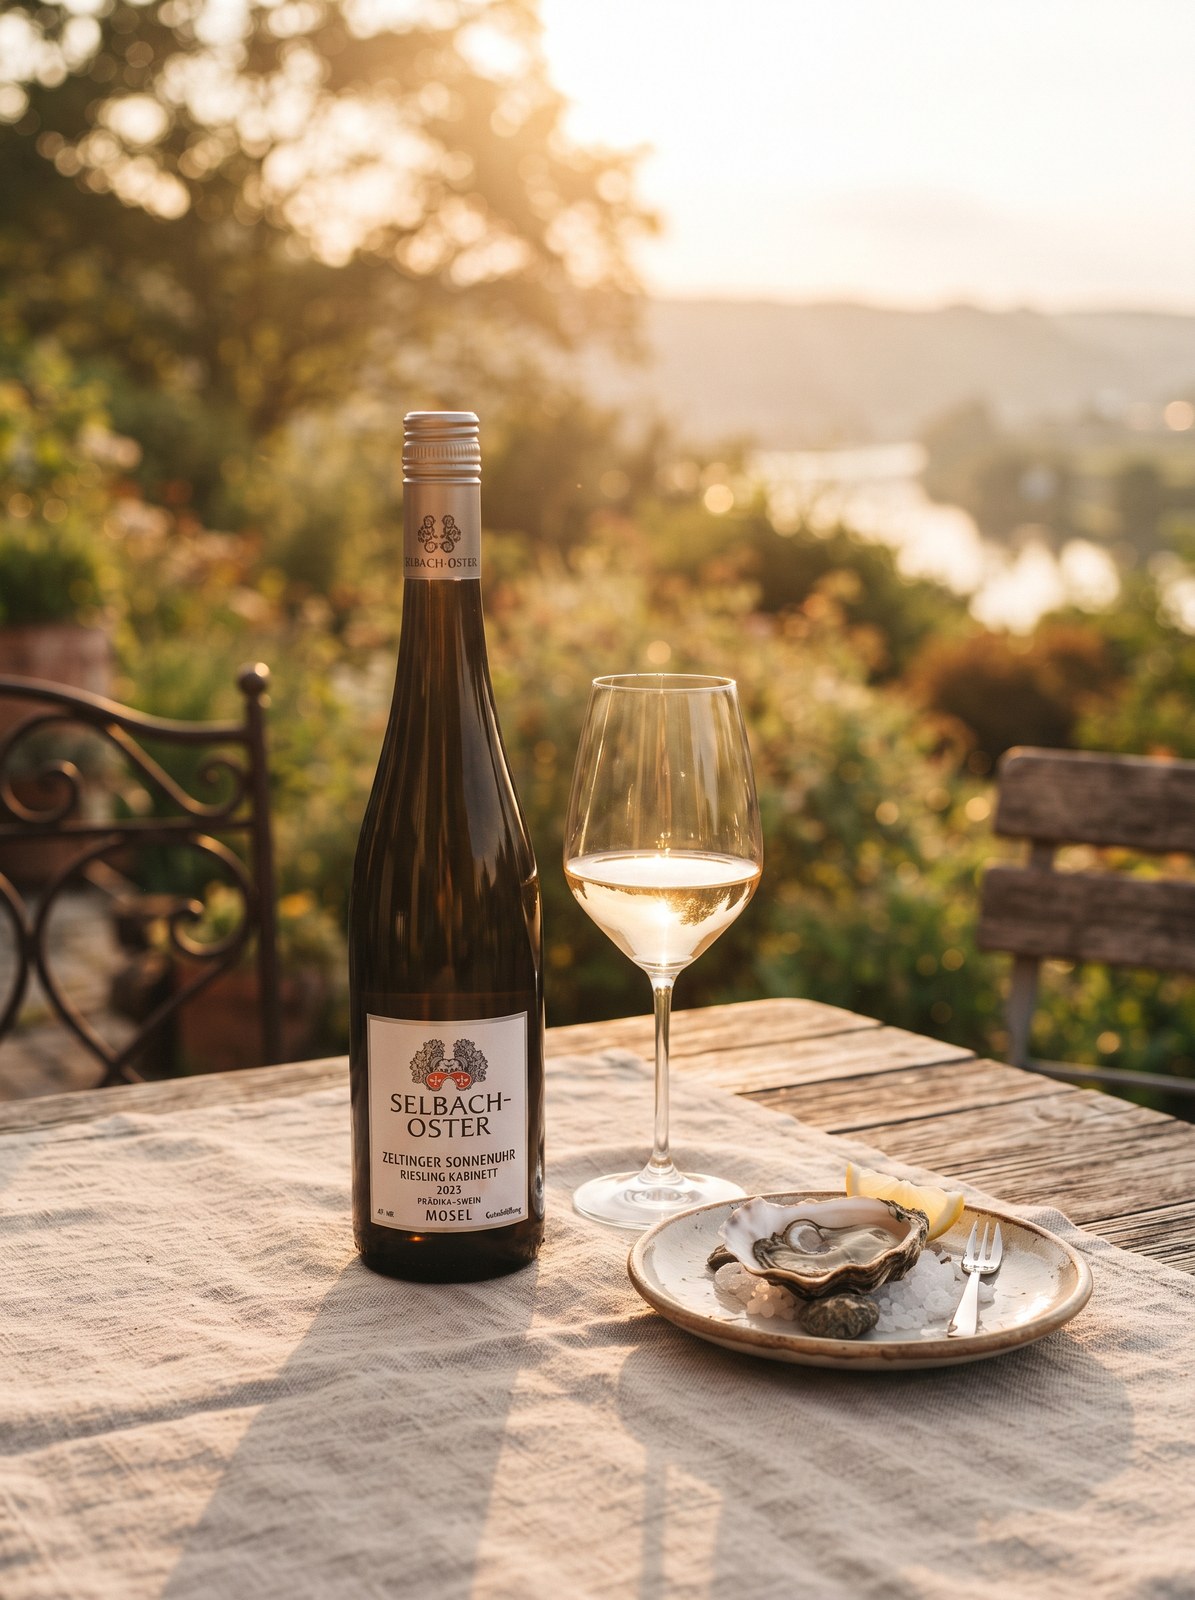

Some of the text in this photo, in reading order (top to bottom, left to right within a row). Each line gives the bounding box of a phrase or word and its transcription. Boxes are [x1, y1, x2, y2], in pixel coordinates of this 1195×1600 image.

[390, 1091, 512, 1116] SELBACH-
[407, 1117, 491, 1138] OSTER
[382, 1149, 516, 1168] ZELTINGER SONNENUHR
[400, 1167, 498, 1182] RIESLING KABINETT
[436, 1185, 462, 1195] 2023
[425, 1209, 473, 1222] MOSEL
